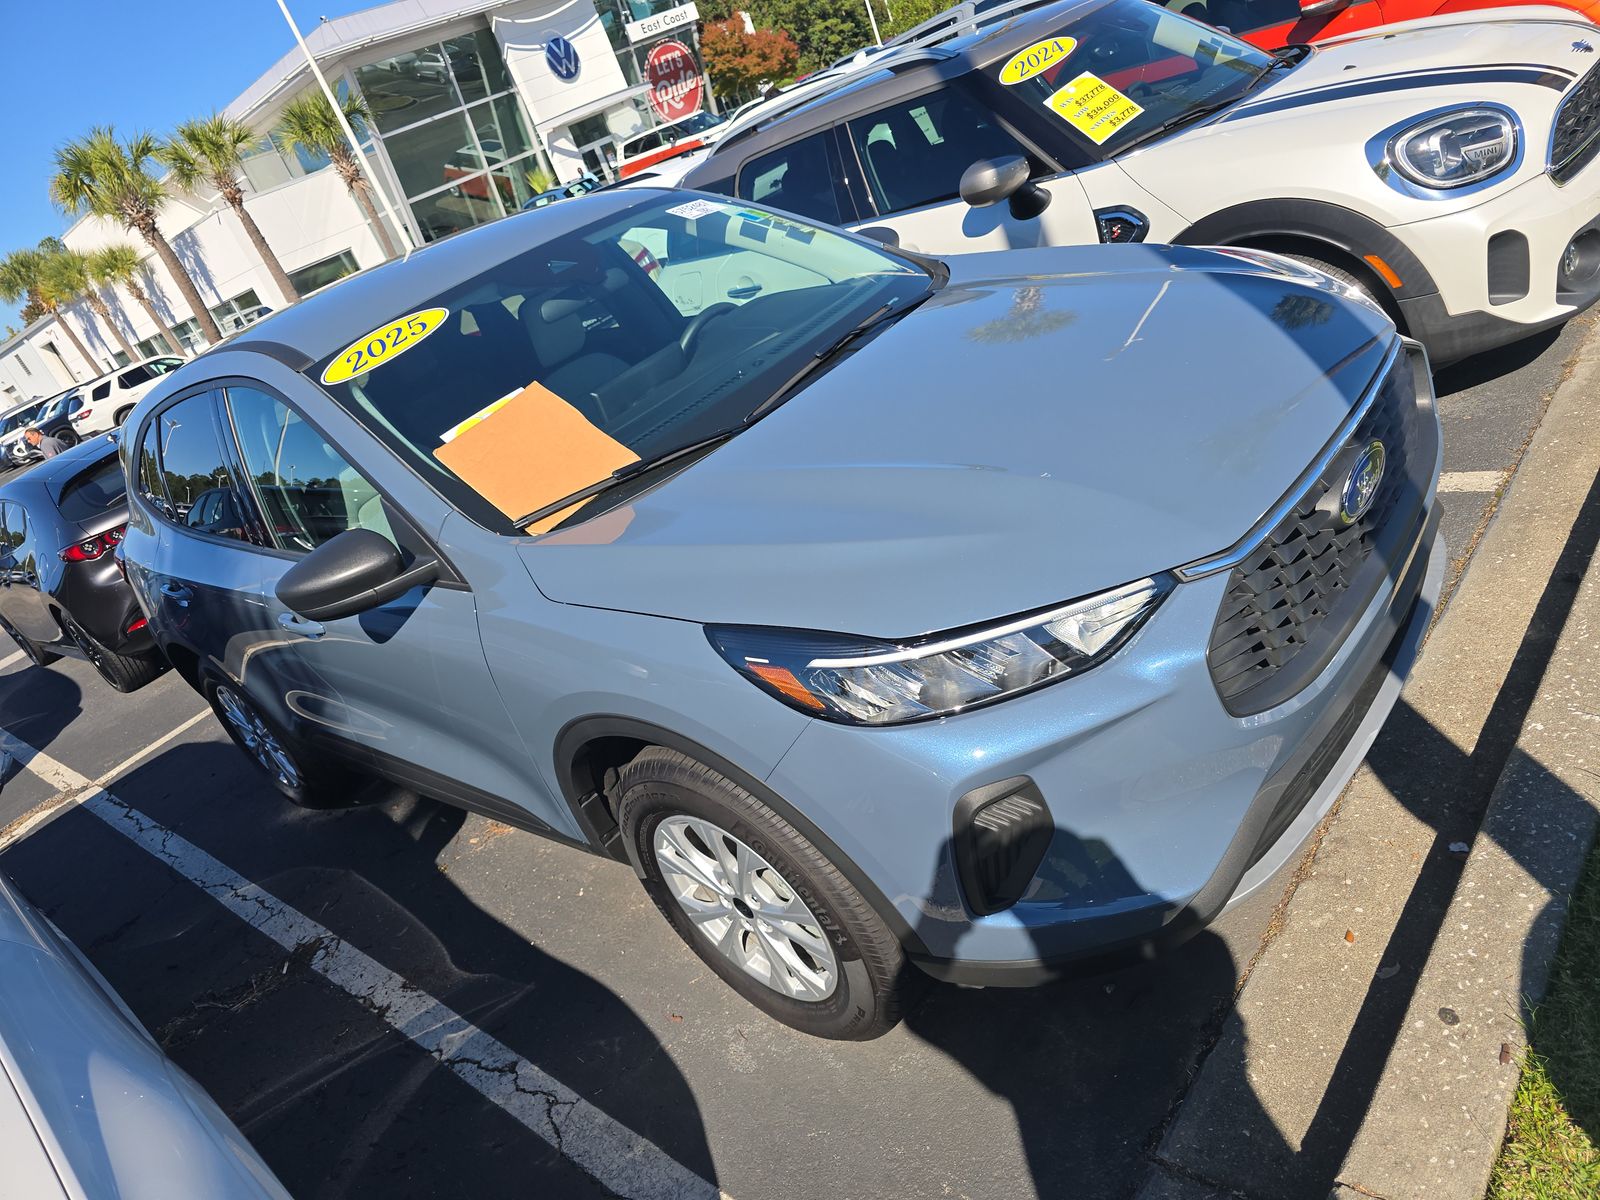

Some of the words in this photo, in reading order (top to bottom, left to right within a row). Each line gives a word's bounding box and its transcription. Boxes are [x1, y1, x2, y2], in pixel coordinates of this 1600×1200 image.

[640, 19, 661, 34] East
[663, 10, 689, 26] Coast
[654, 50, 684, 76] LET'S
[1015, 41, 1064, 77] 2024
[655, 68, 697, 115] Ride
[1075, 84, 1106, 107] $37,778
[1086, 93, 1120, 120] $34,000
[1108, 105, 1137, 127] $3,778
[1474, 147, 1497, 158] MINI
[347, 316, 427, 373] 2025
